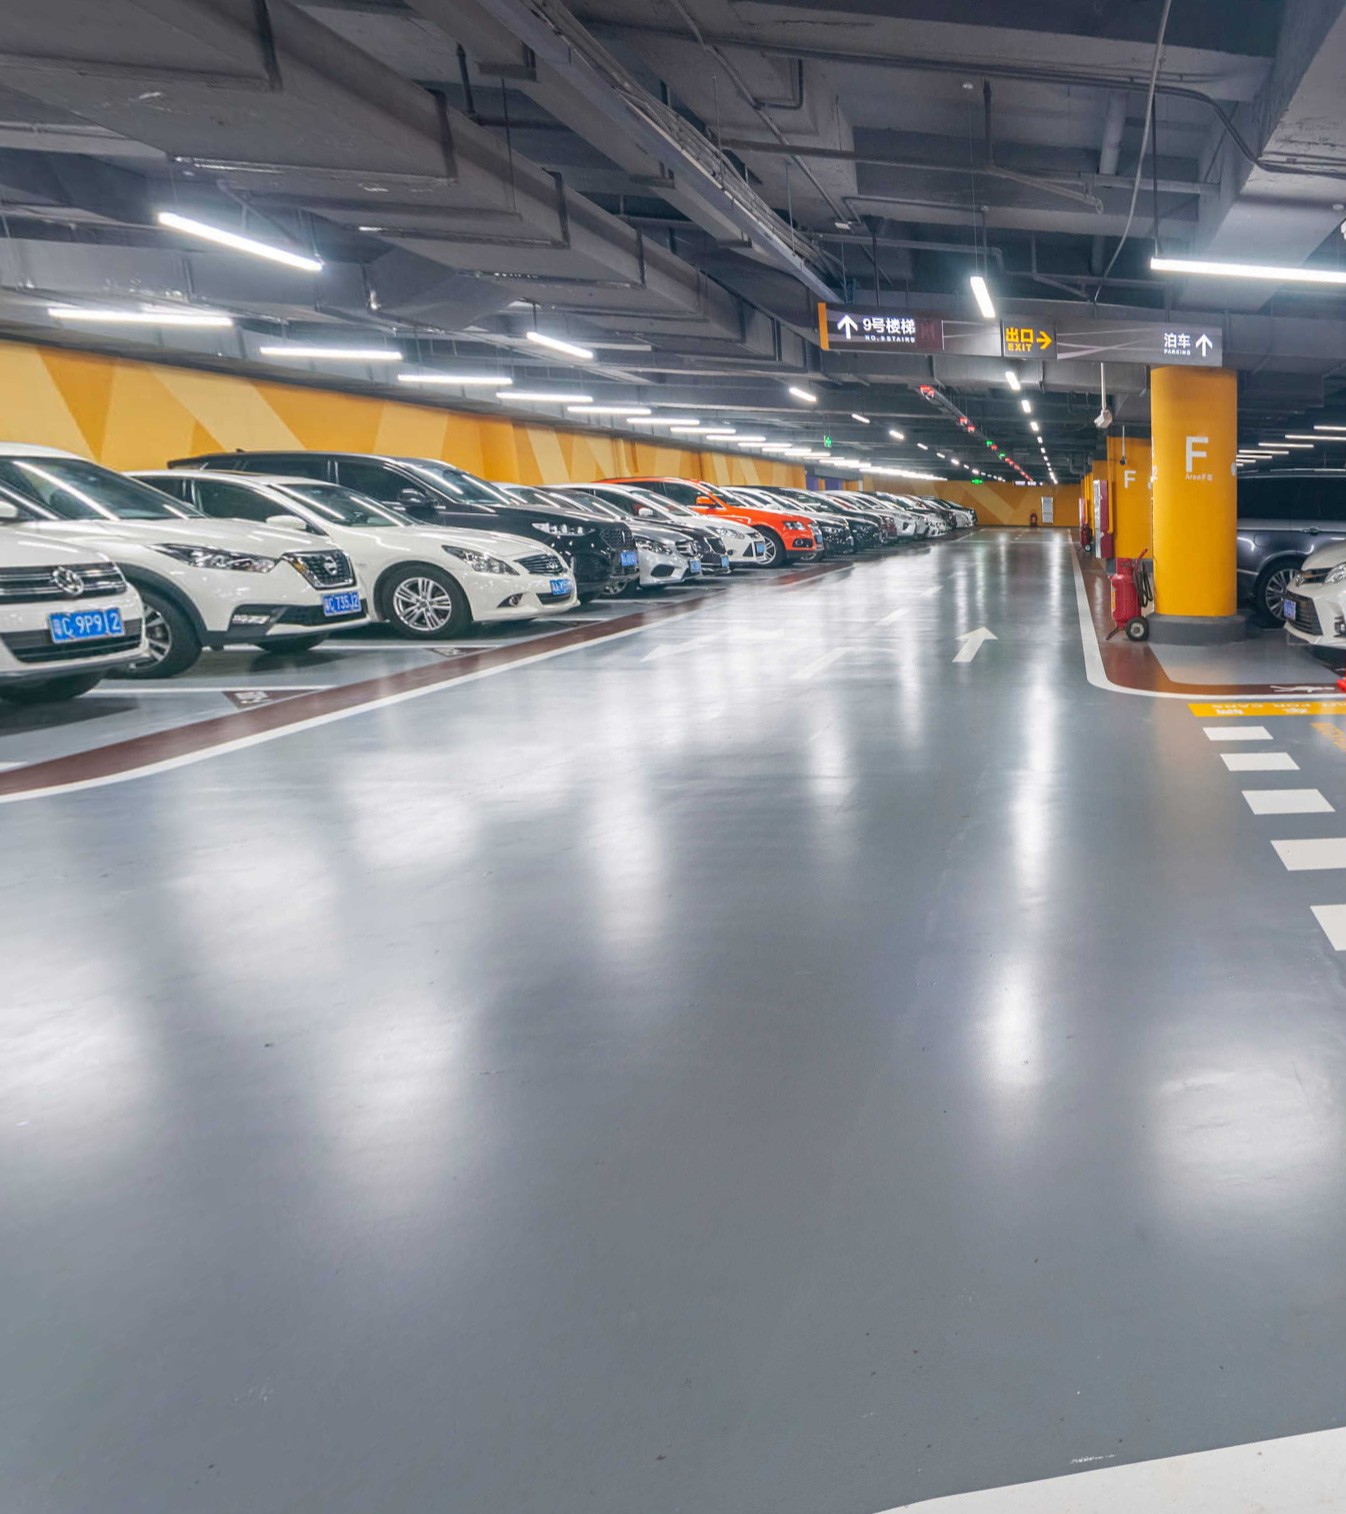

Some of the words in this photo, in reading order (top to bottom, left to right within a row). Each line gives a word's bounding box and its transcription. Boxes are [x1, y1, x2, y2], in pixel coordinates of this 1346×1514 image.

[863, 317, 916, 334] 9号楼梯
[1005, 327, 1034, 342] 出口
[1163, 332, 1191, 349] 泊车
[1007, 342, 1032, 352] EXIT
[1185, 436, 1209, 473] F
[1123, 470, 1137, 489] F
